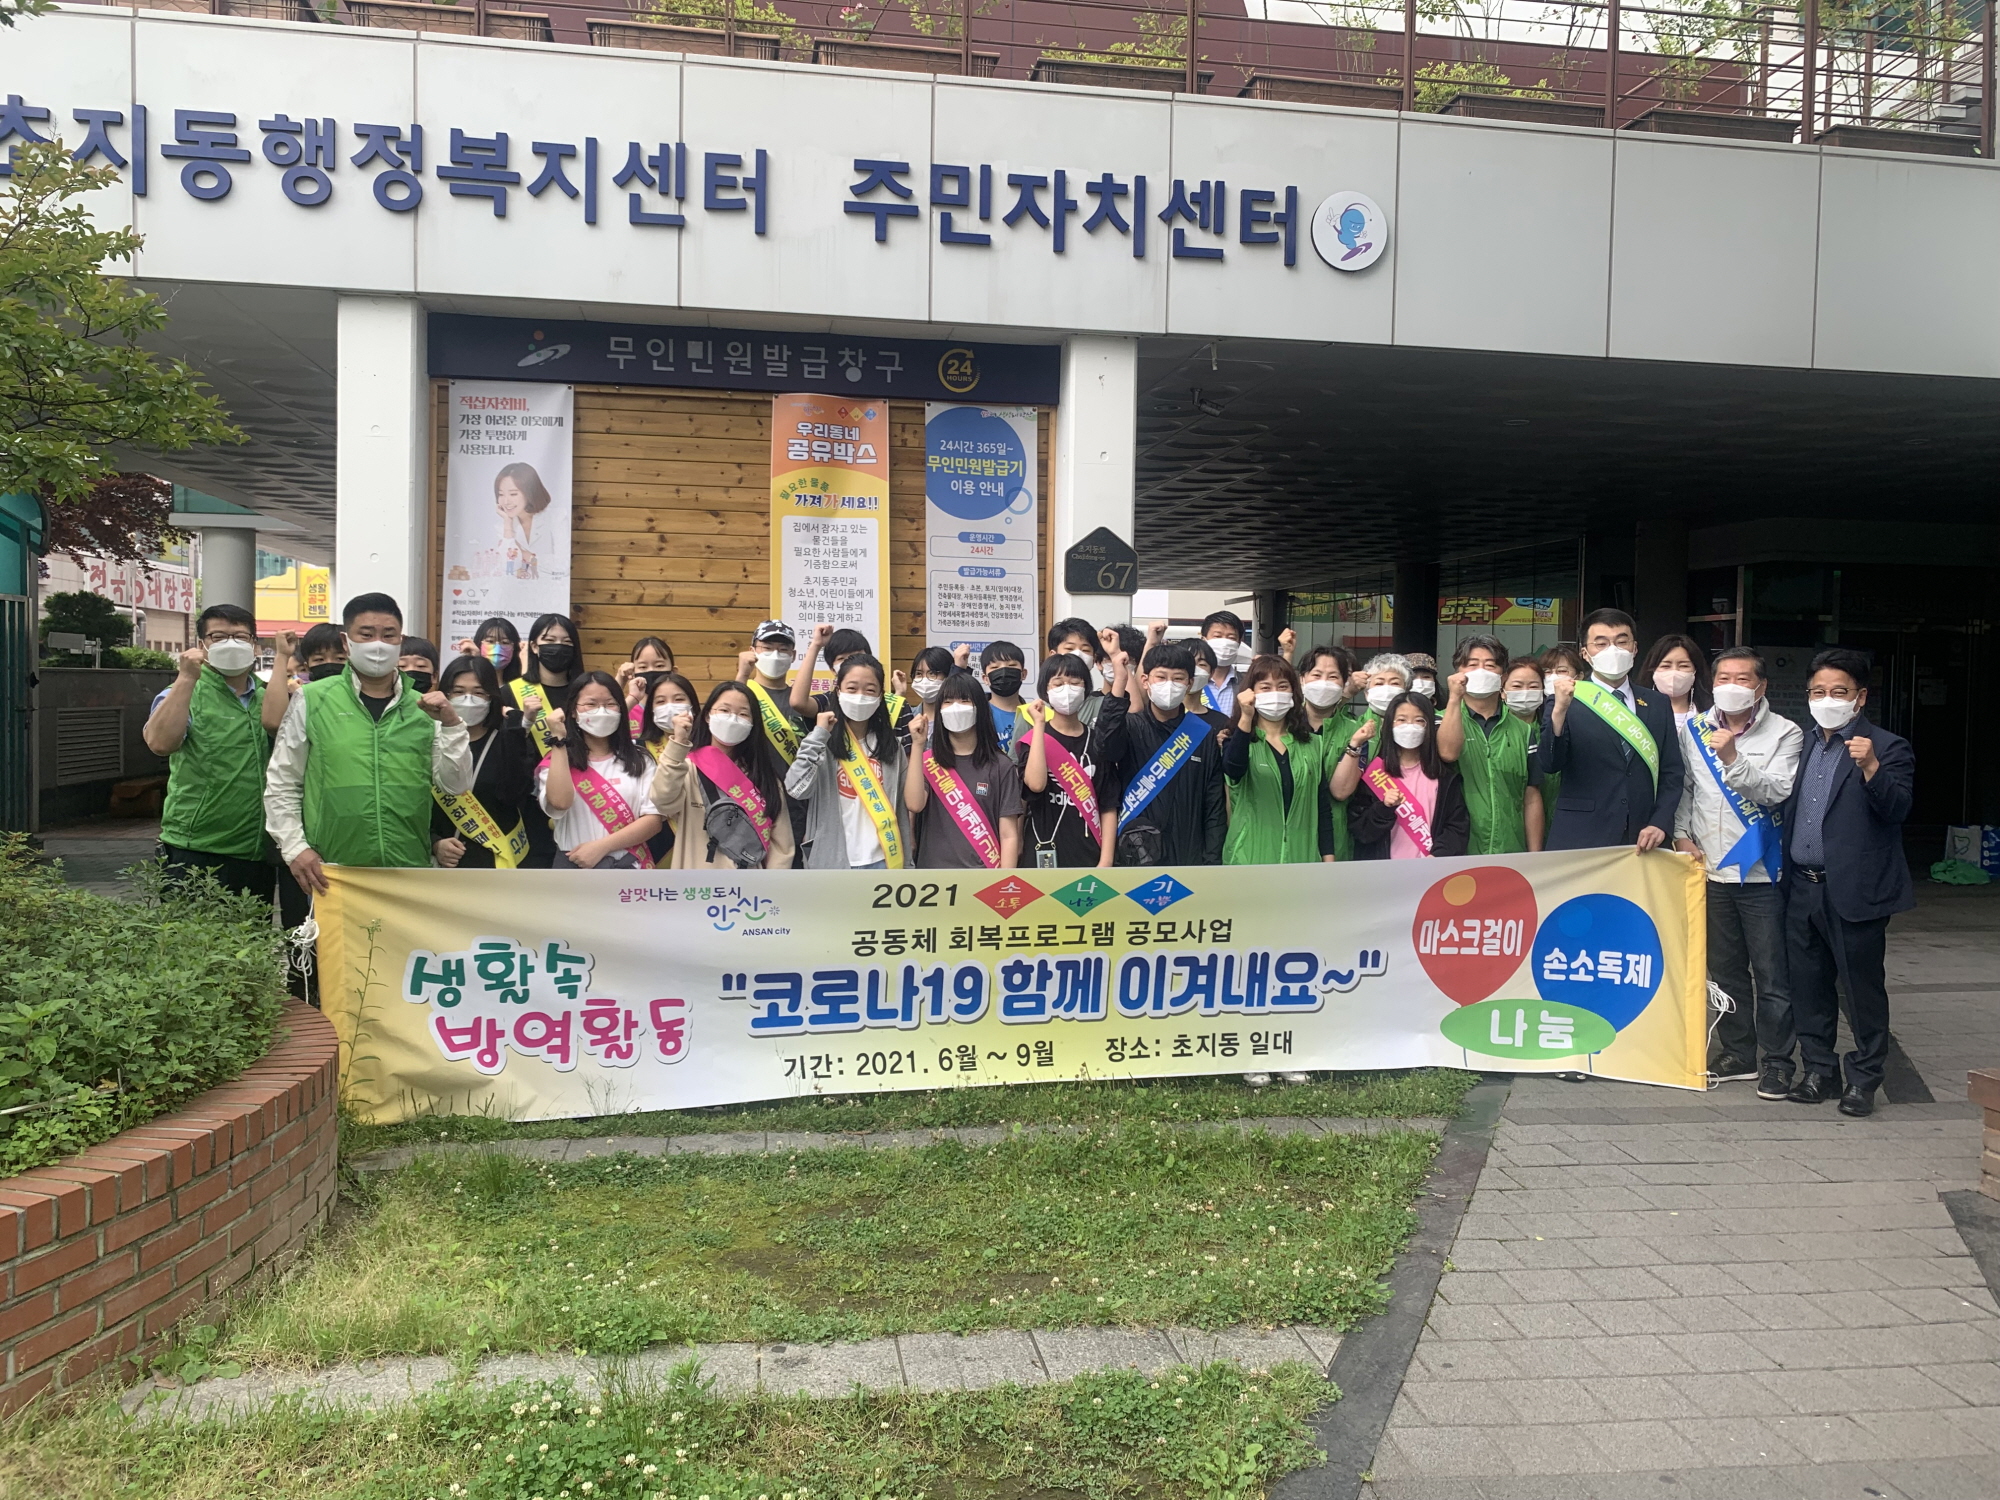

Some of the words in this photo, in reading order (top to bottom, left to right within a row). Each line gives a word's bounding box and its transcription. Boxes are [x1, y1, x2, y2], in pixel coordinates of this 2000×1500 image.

[843, 158, 1298, 267] 주민자치센터
[606, 337, 904, 384] 무인민원발급창구
[947, 358, 973, 375] 24
[945, 374, 973, 383] HOURS
[459, 396, 530, 412] 적십자회비,
[459, 414, 481, 425] 가장
[521, 416, 564, 427] 이웃에게
[459, 429, 481, 440] 가장
[796, 422, 860, 441] 우리동네
[459, 444, 515, 455] 사용됩니다.
[787, 438, 877, 464] 공유박스
[940, 440, 974, 453] 24시간
[976, 442, 1014, 455] 365일~
[927, 455, 1023, 477] 무인민원발급기
[780, 478, 808, 500] 필요한
[950, 480, 975, 495] 이용
[979, 481, 1004, 497] 안내
[794, 493, 879, 510] 가져가세요!!
[793, 522, 819, 533] 집에서
[821, 524, 848, 534] 잠자고
[850, 524, 868, 534] 있는
[812, 536, 848, 546] 물건들을
[969, 533, 995, 543] 운영시간
[794, 547, 820, 557] 필요한
[822, 548, 867, 558] 사람들에게
[970, 546, 994, 555] 24시간
[804, 560, 858, 569] 기증함으로써
[963, 567, 1002, 577] 발급가능서류
[803, 576, 857, 586] 초지동주민과
[1097, 562, 1134, 589] 67
[308, 583, 327, 593] 생활
[788, 587, 817, 598] 청소년,
[820, 589, 874, 598] 어린이들에게
[308, 594, 327, 604] 공구
[798, 600, 834, 610] 재사용과
[836, 601, 863, 611] 나눔의
[308, 604, 327, 615] 렌탈
[798, 612, 825, 622] 의미를
[827, 613, 863, 623] 알게하고
[618, 887, 679, 903] 살맛나는
[682, 886, 741, 901] 생생도시
[872, 883, 959, 909] 2021
[999, 881, 1022, 893] 소
[1076, 881, 1098, 894] 나
[1152, 880, 1174, 893] 기
[994, 897, 1021, 910] 소통
[1069, 895, 1098, 907] 나눔
[1143, 895, 1173, 906] 기쁨
[706, 896, 773, 931] 안산
[742, 928, 774, 937] ANSAN
[774, 927, 791, 936] city
[851, 926, 938, 957] 공동체
[948, 921, 1116, 952] 회복프로그램
[1125, 918, 1234, 945] 공모사업
[1418, 918, 1524, 957] 마스크걸이
[1542, 947, 1653, 989] 손소독제
[722, 964, 984, 1029] "코로나19
[1000, 956, 1104, 1017] 함께
[1118, 949, 1381, 1011] 이겨내요~"
[435, 999, 686, 1068] 방역활동
[1489, 1008, 1575, 1049] 나눔
[1105, 1036, 1161, 1063] 장소:
[1171, 1032, 1240, 1059] 초지동
[1249, 1030, 1293, 1056] 일대
[783, 1053, 845, 1080] 기간:
[856, 1049, 930, 1076] 2021.
[938, 1043, 978, 1072] 6월
[1016, 1040, 1055, 1068] 9월
